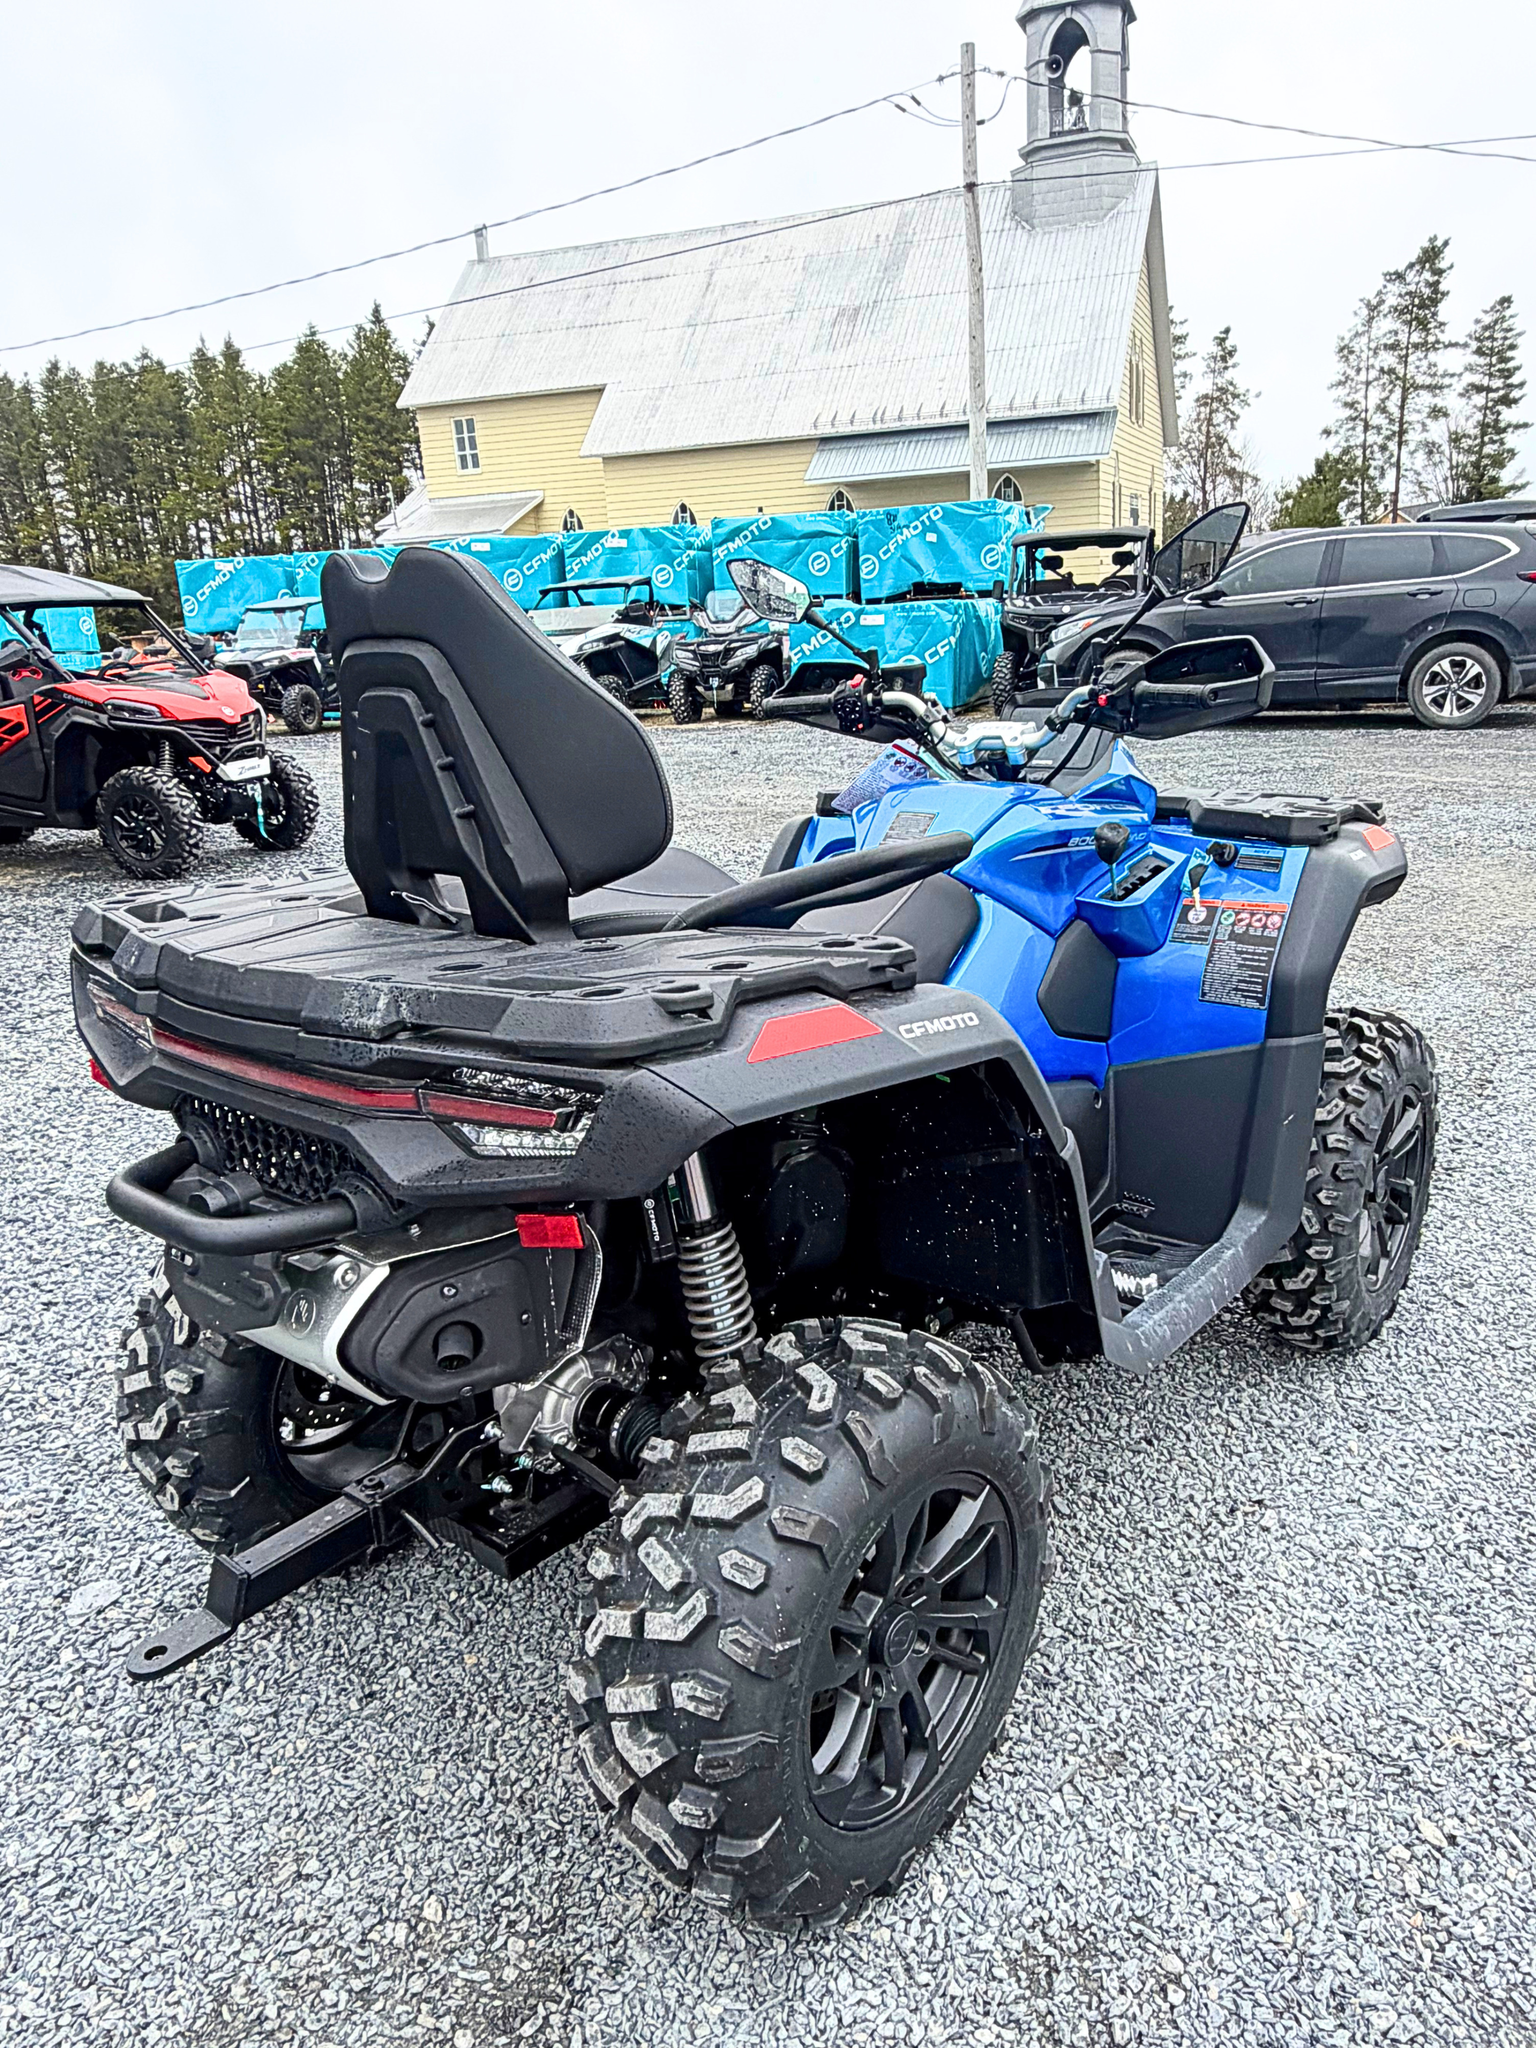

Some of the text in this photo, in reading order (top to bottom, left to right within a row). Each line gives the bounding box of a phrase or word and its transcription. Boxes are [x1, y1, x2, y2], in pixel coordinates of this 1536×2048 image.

[879, 505, 943, 560] CFMOTO
[898, 1011, 980, 1039] CFMOTO
[648, 1209, 660, 1242] CFMOTO
